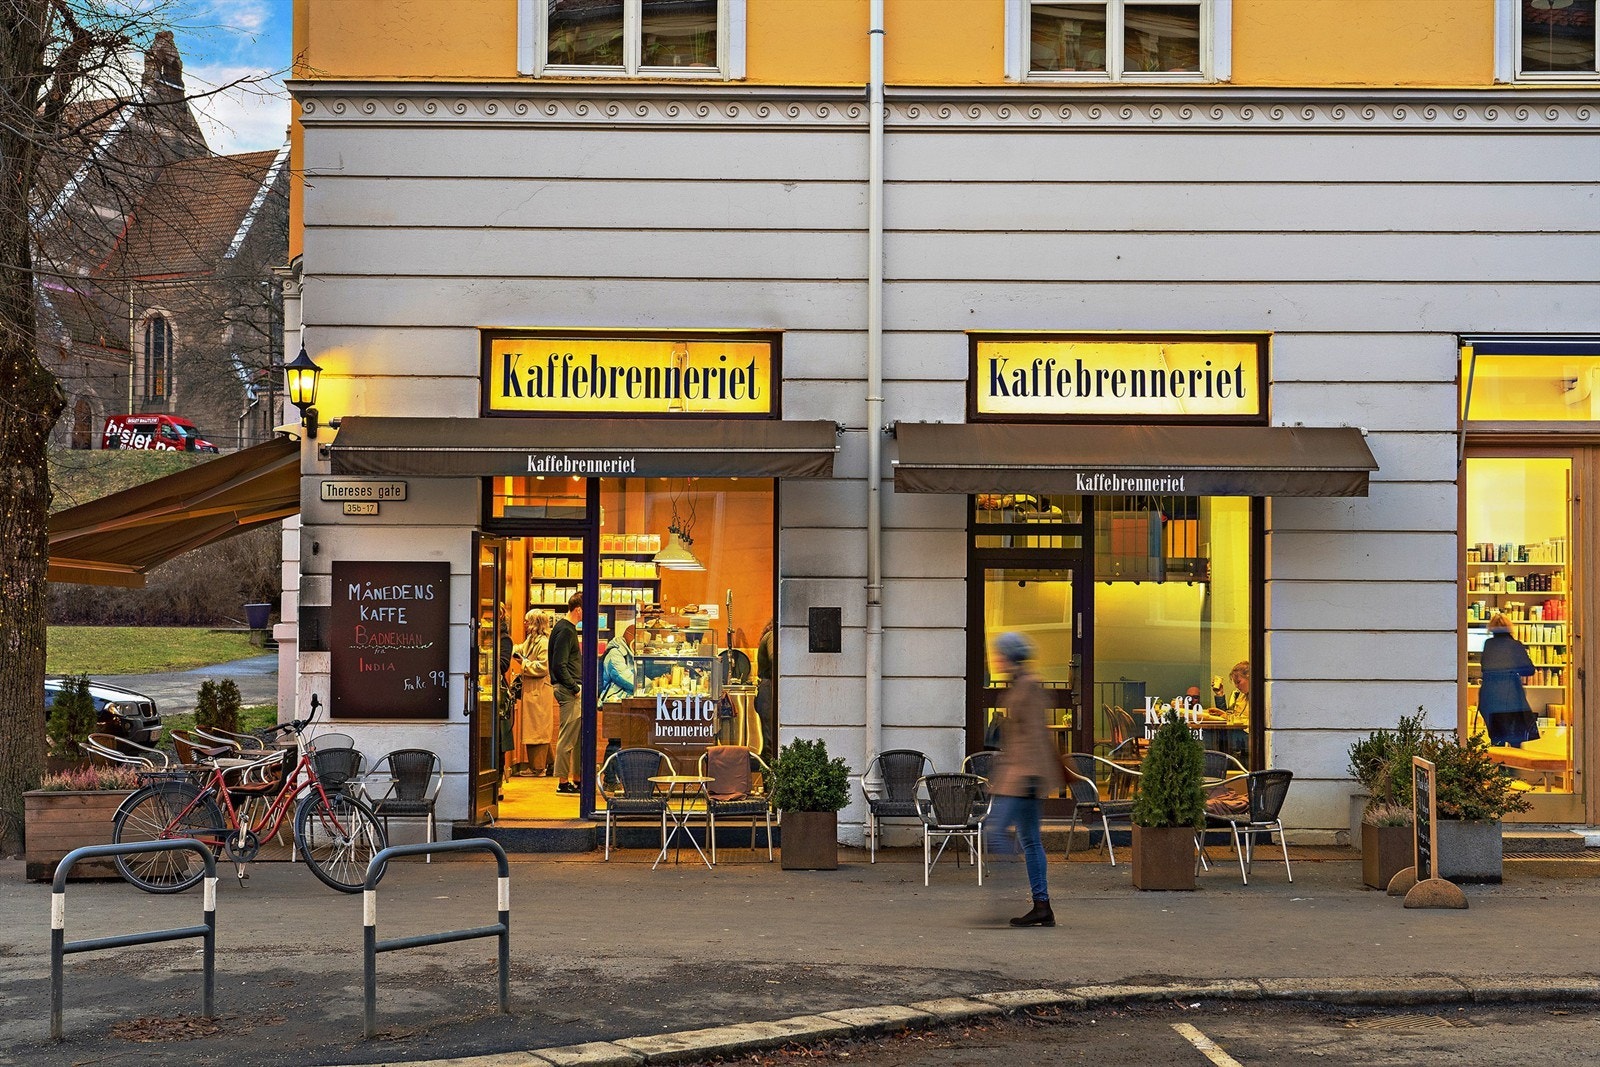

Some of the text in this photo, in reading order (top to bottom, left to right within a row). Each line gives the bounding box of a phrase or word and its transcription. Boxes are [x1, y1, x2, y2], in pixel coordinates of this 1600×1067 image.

[501, 352, 760, 400] Kaffebrenneriet
[988, 358, 1247, 399] Kaffebrenneriet
[526, 455, 637, 474] Kaffebrenneriet
[326, 484, 401, 498] Thereses gate
[1075, 473, 1186, 493] Kaffebrenneriet
[348, 581, 434, 601] MÅNEDENS
[360, 604, 408, 624] KAFFE
[655, 693, 715, 721] Kaffe
[1144, 696, 1204, 725] Kaffe
[655, 722, 714, 737] brenneriet
[1144, 725, 1204, 740] briet
